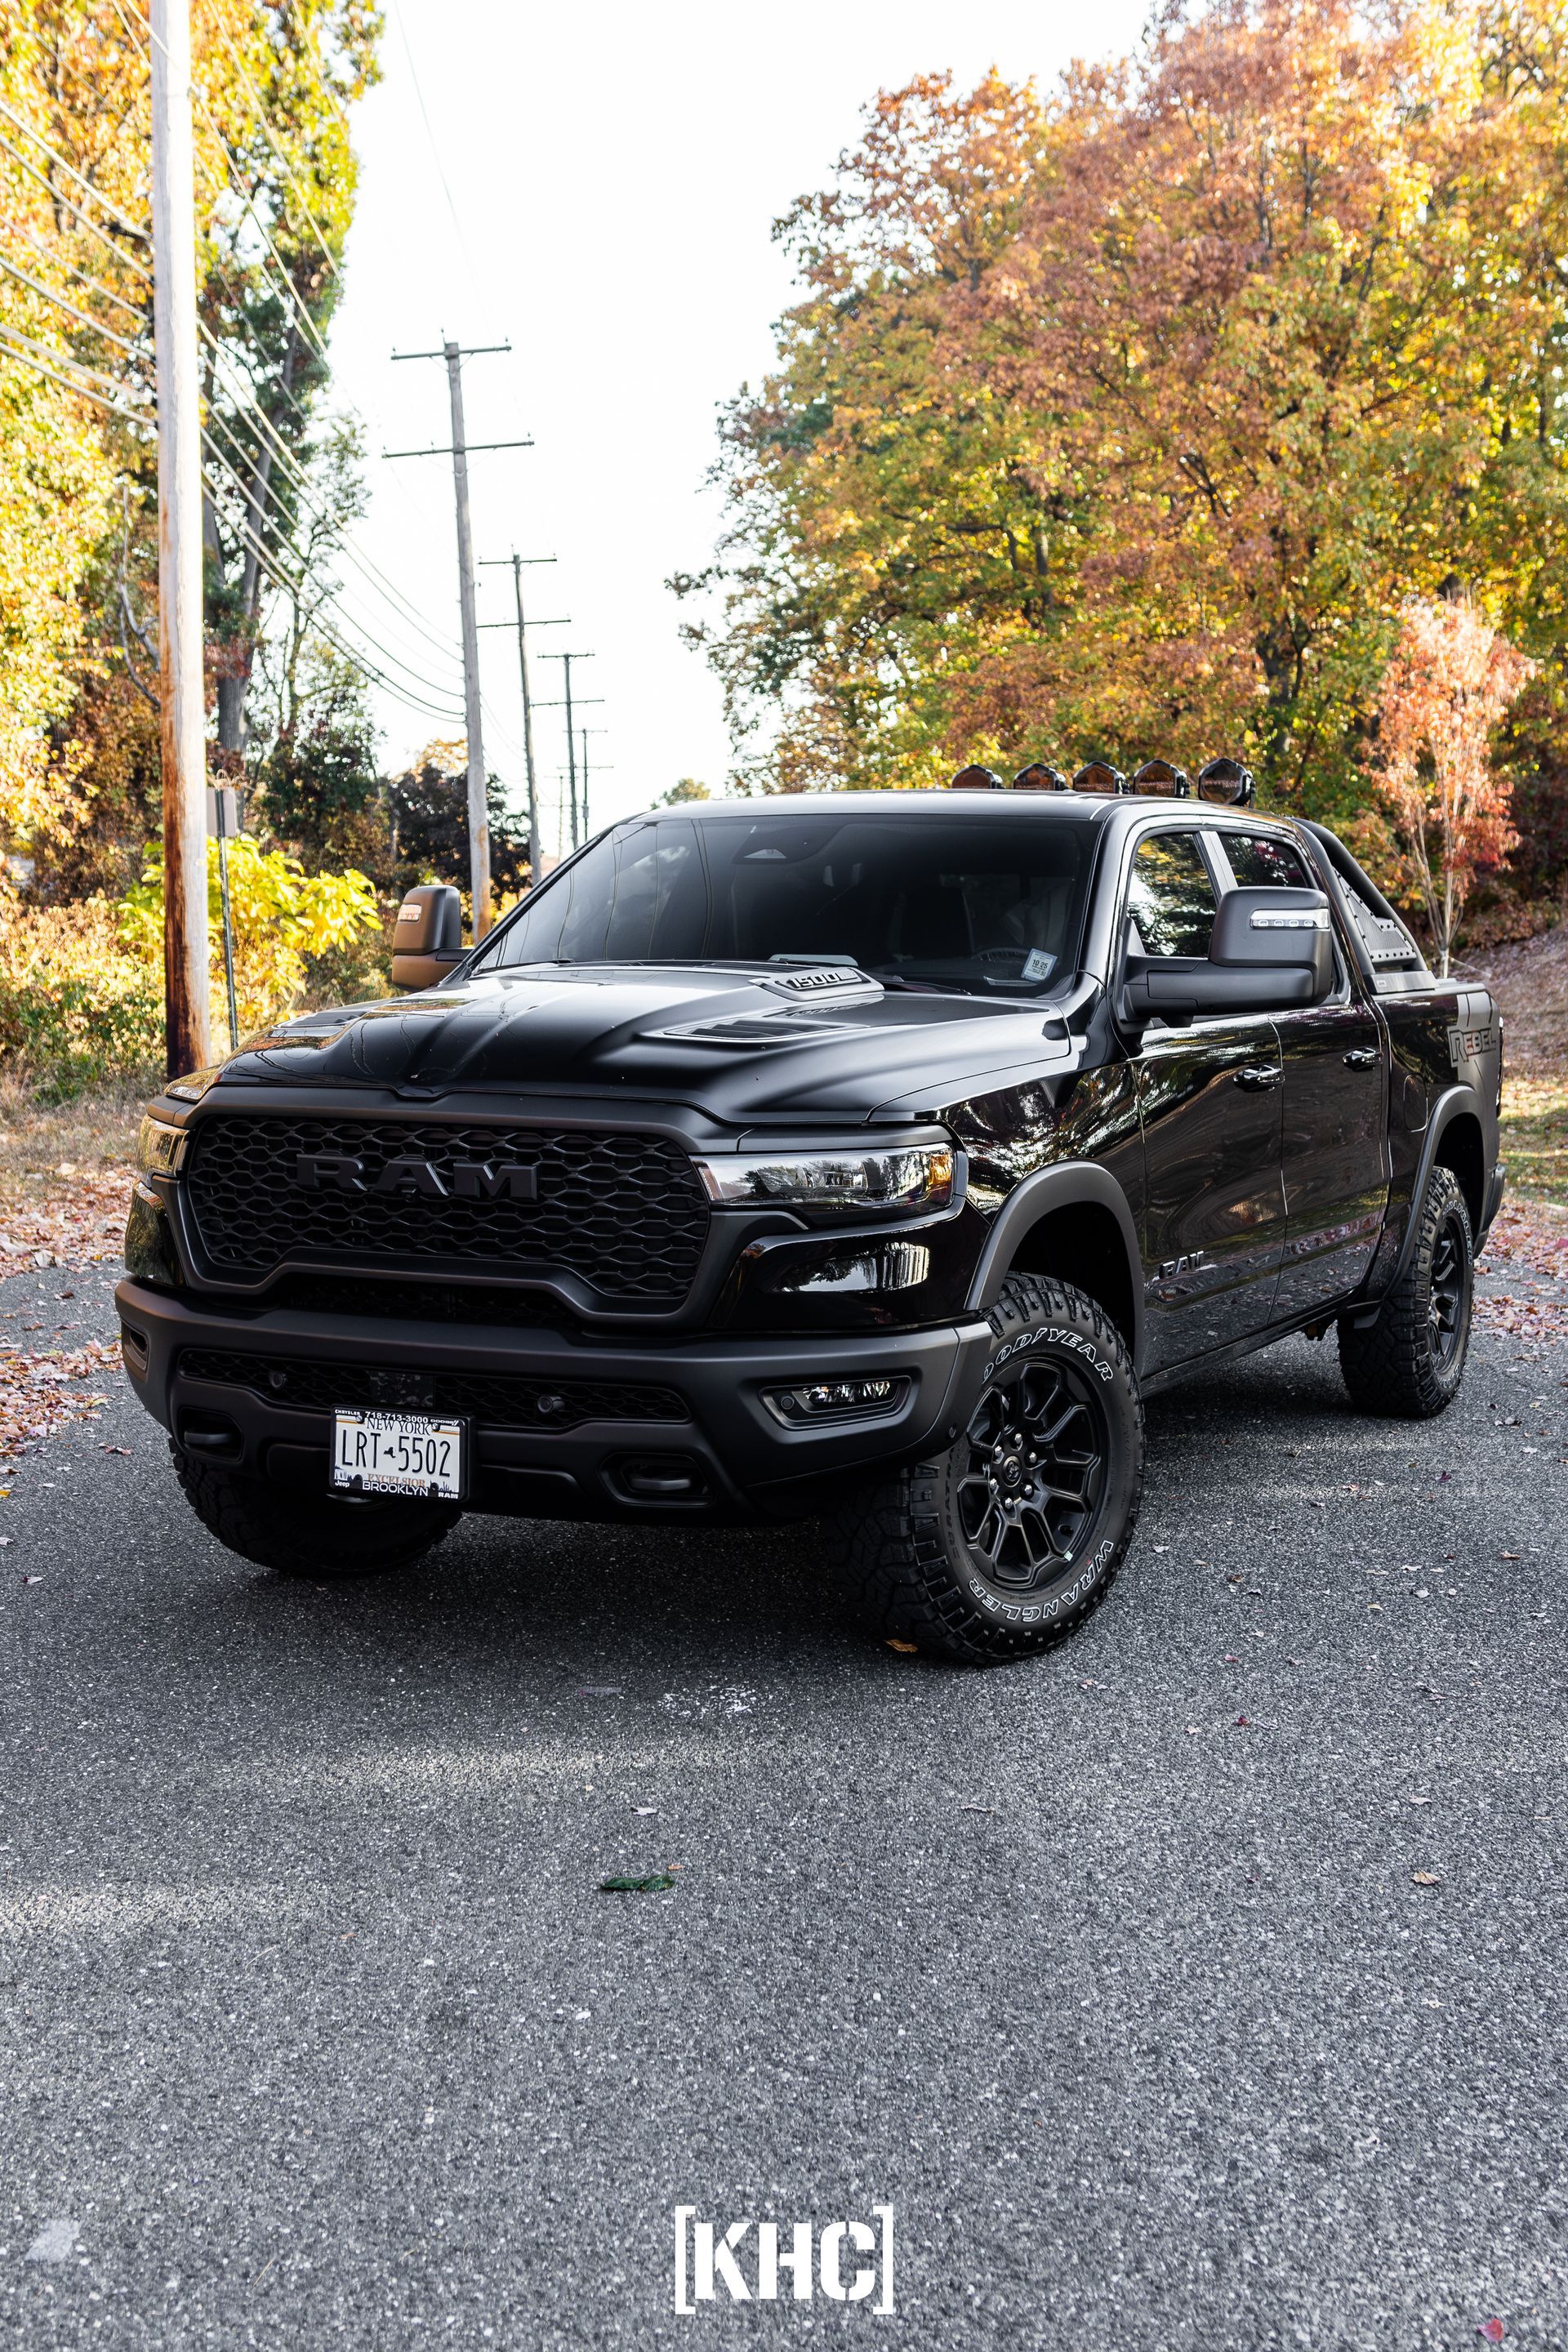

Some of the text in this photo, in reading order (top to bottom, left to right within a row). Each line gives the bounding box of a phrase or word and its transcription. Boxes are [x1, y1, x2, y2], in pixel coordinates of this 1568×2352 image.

[788, 973, 840, 988] 1500
[1450, 1027, 1497, 1062] REBEL
[296, 1154, 538, 1200] RAM
[981, 1326, 1114, 1386] OODYEAR
[365, 1411, 429, 1423] 718-713-3000
[367, 1419, 431, 1436] NEW YORK
[341, 1430, 451, 1477] LRT 5502
[362, 1481, 429, 1497] BROOKLYN
[969, 1539, 1114, 1623] WRANGLER
